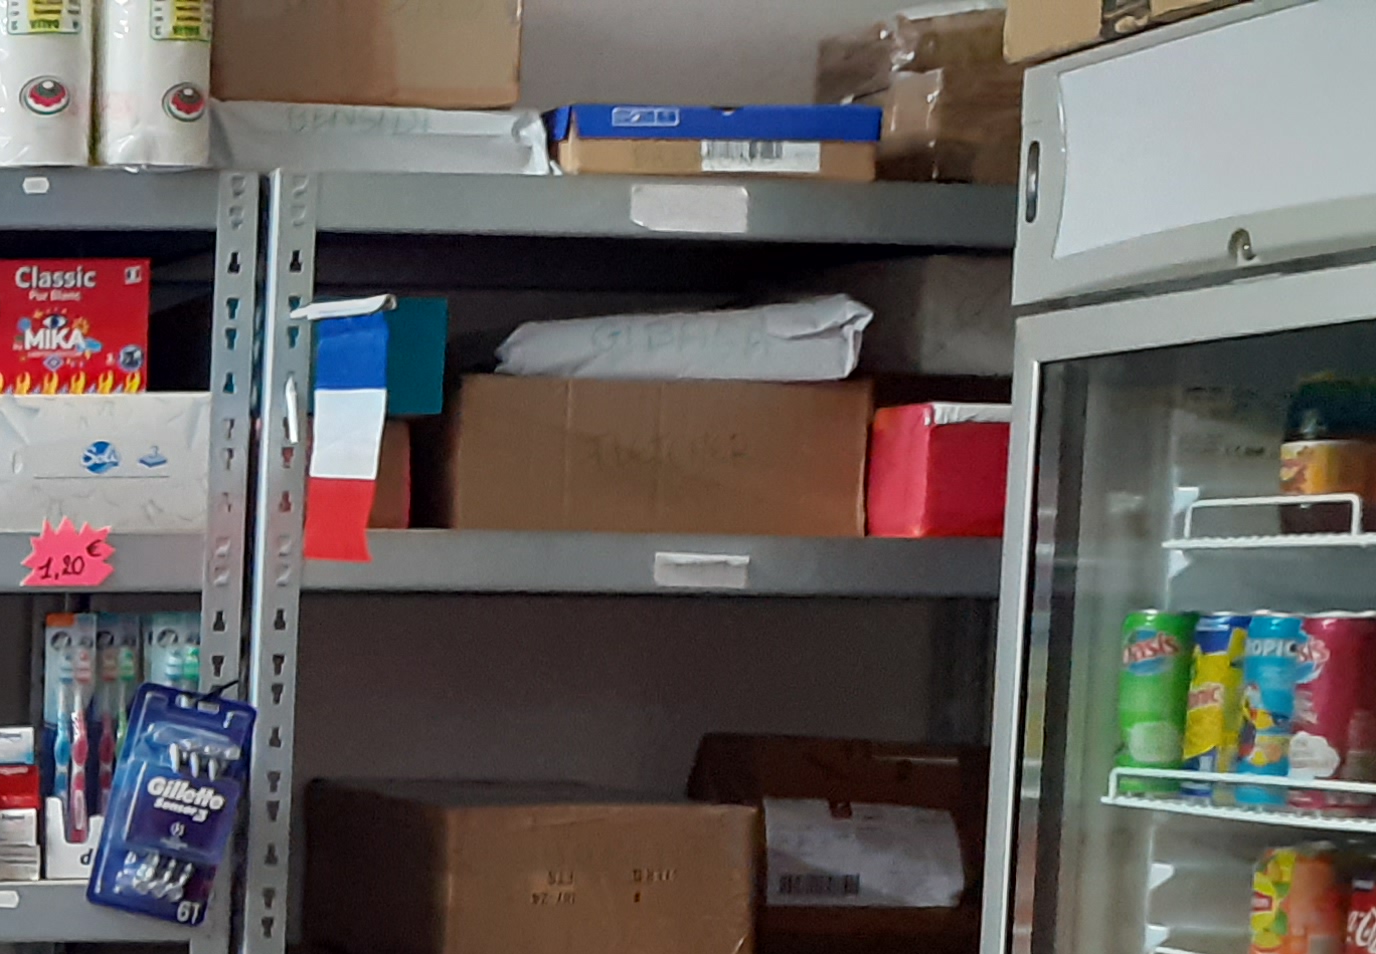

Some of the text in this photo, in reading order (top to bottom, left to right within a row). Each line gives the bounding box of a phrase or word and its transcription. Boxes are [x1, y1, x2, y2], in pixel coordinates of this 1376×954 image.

[15, 265, 97, 289] Classic
[23, 328, 87, 350] MIKA
[148, 775, 225, 813] Gillette
